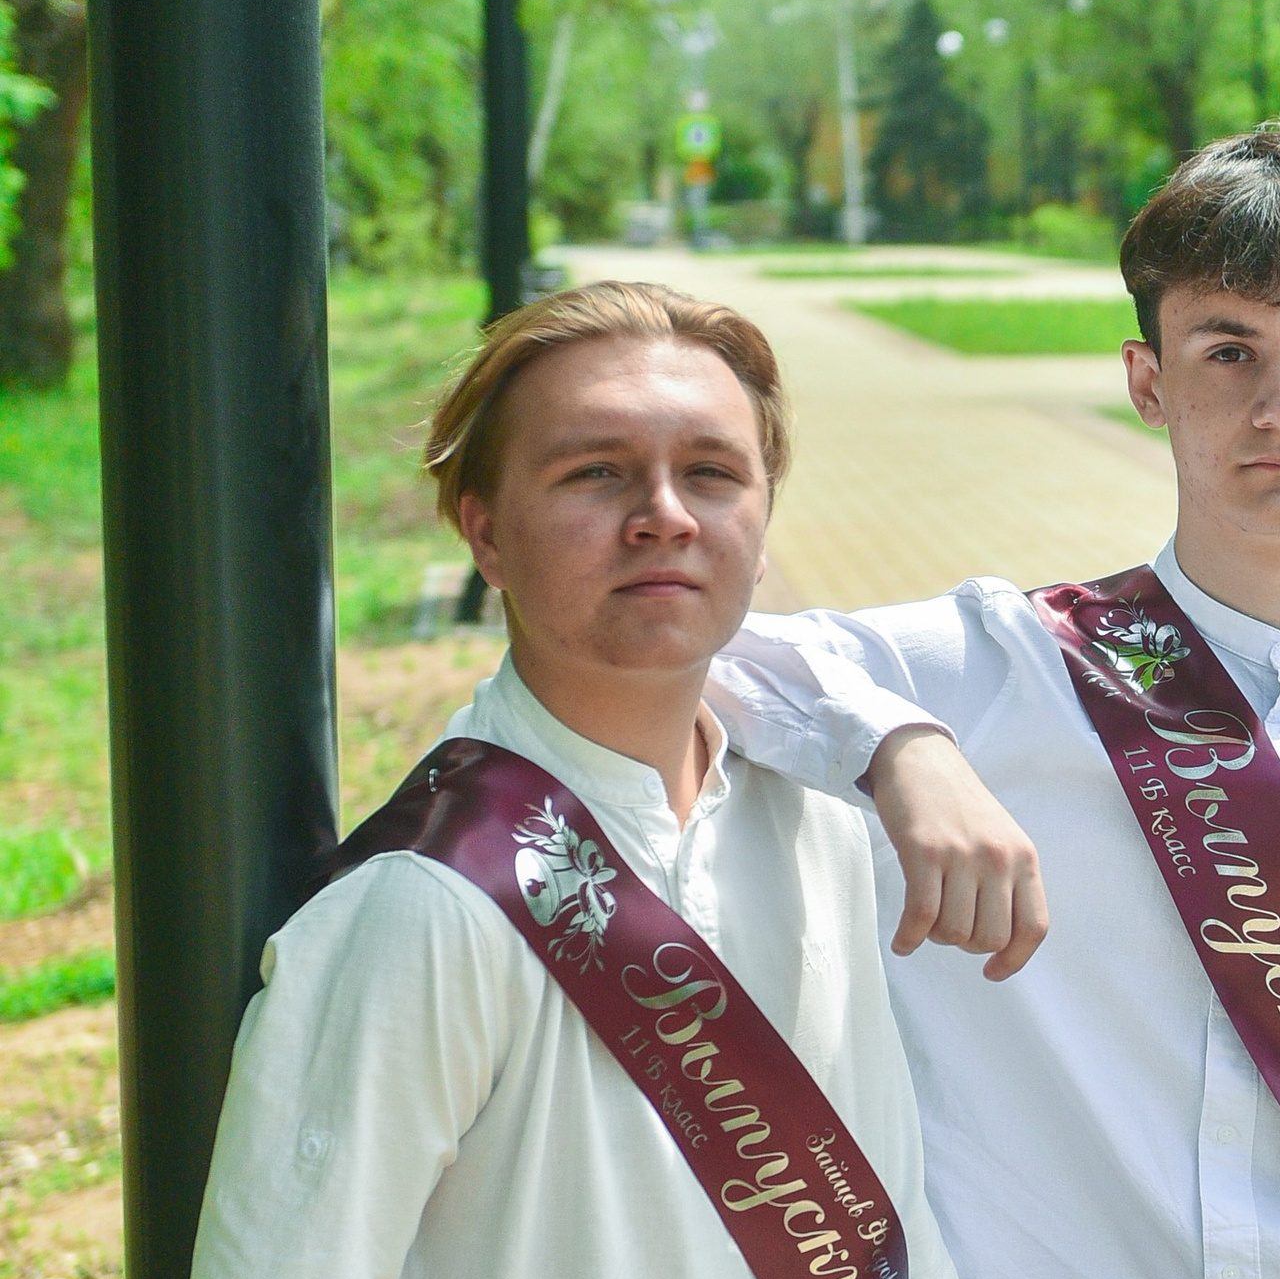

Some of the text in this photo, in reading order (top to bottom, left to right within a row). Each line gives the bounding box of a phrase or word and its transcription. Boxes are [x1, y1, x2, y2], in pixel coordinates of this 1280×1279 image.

[1123, 745, 1156, 774] 11
[1151, 807, 1196, 878] класс
[660, 1082, 708, 1149] класс
[806, 1127, 874, 1219] Зайцев
